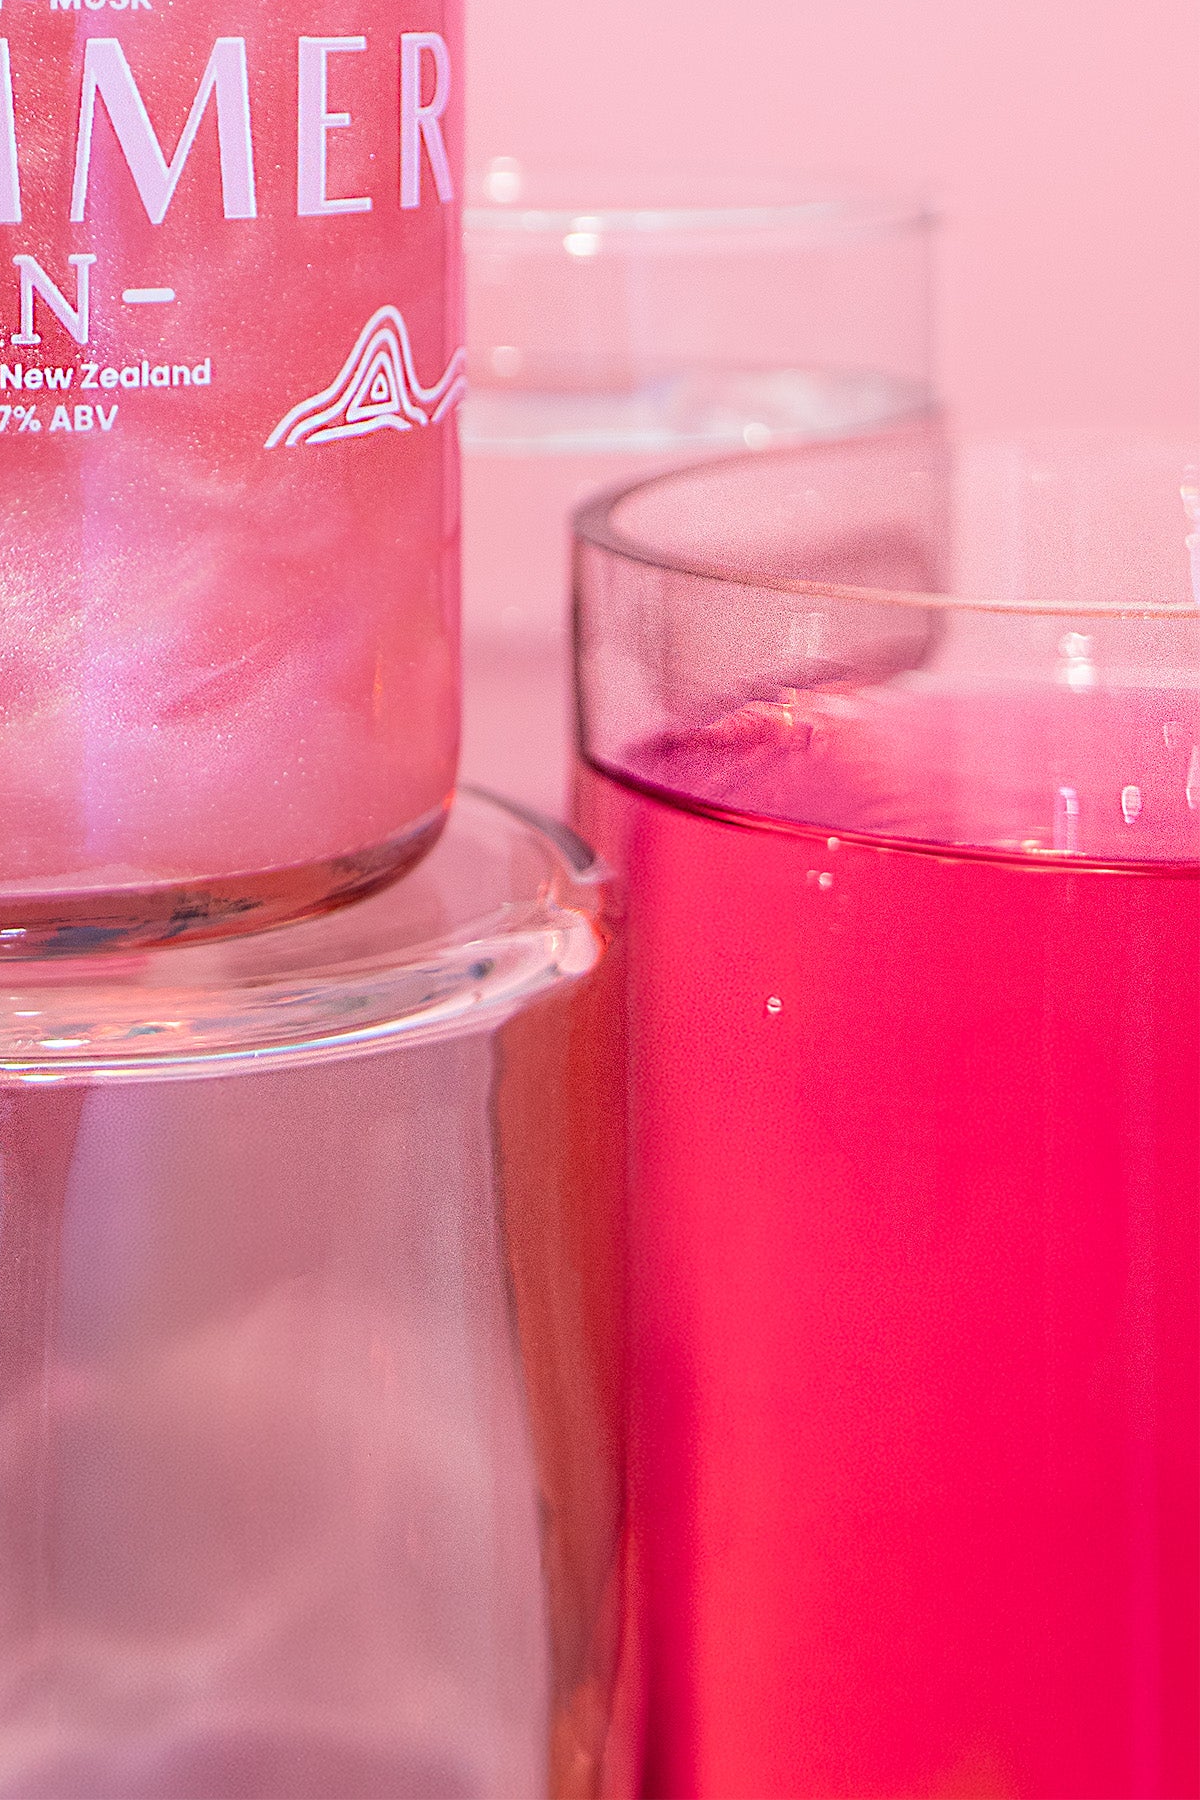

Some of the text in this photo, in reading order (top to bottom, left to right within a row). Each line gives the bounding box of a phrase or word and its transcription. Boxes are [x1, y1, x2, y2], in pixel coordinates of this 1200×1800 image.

[0, 361, 74, 389] New
[81, 358, 211, 388] Zealand
[49, 404, 119, 432] ABV
